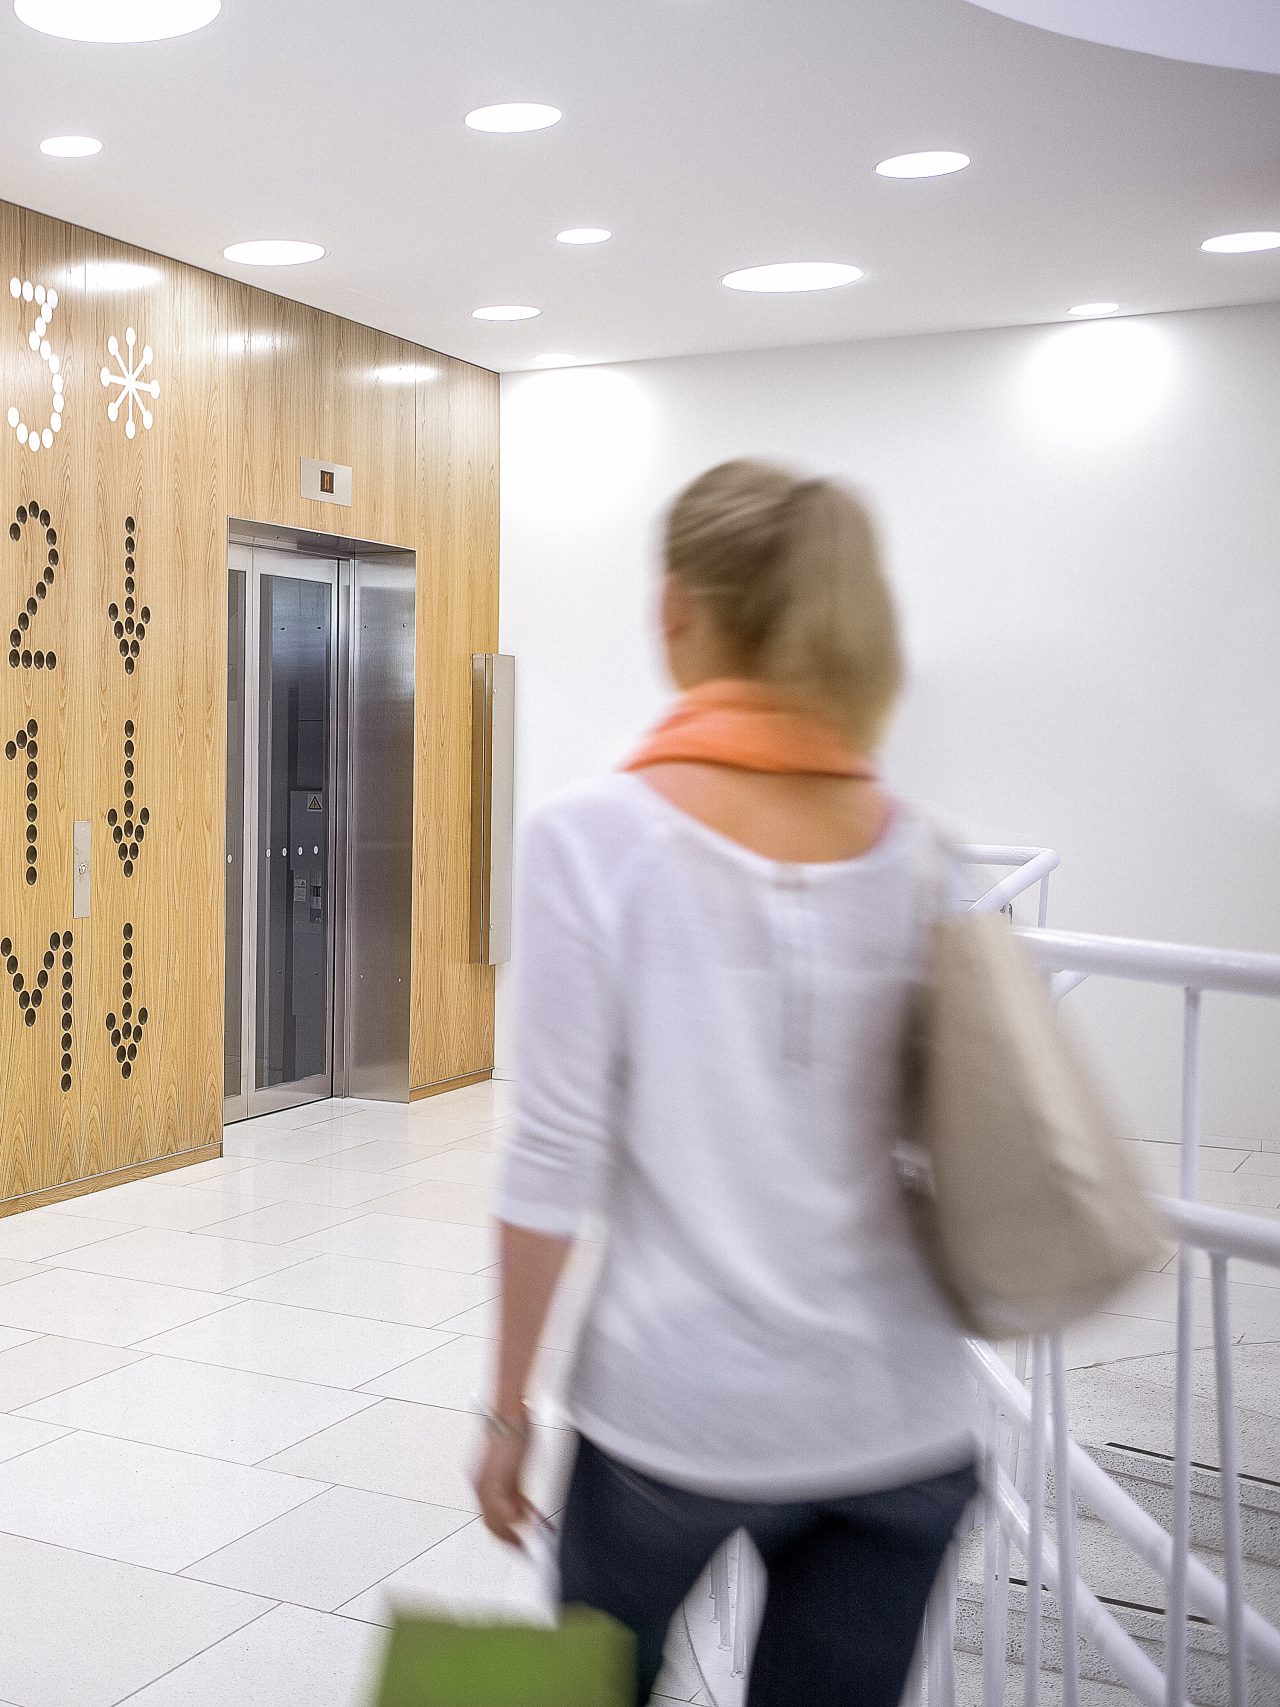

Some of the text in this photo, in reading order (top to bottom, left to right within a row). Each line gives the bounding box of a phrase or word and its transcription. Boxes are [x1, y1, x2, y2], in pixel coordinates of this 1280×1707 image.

[8, 276, 66, 453] 3
[7, 500, 60, 670] 2
[5, 718, 40, 886] 1
